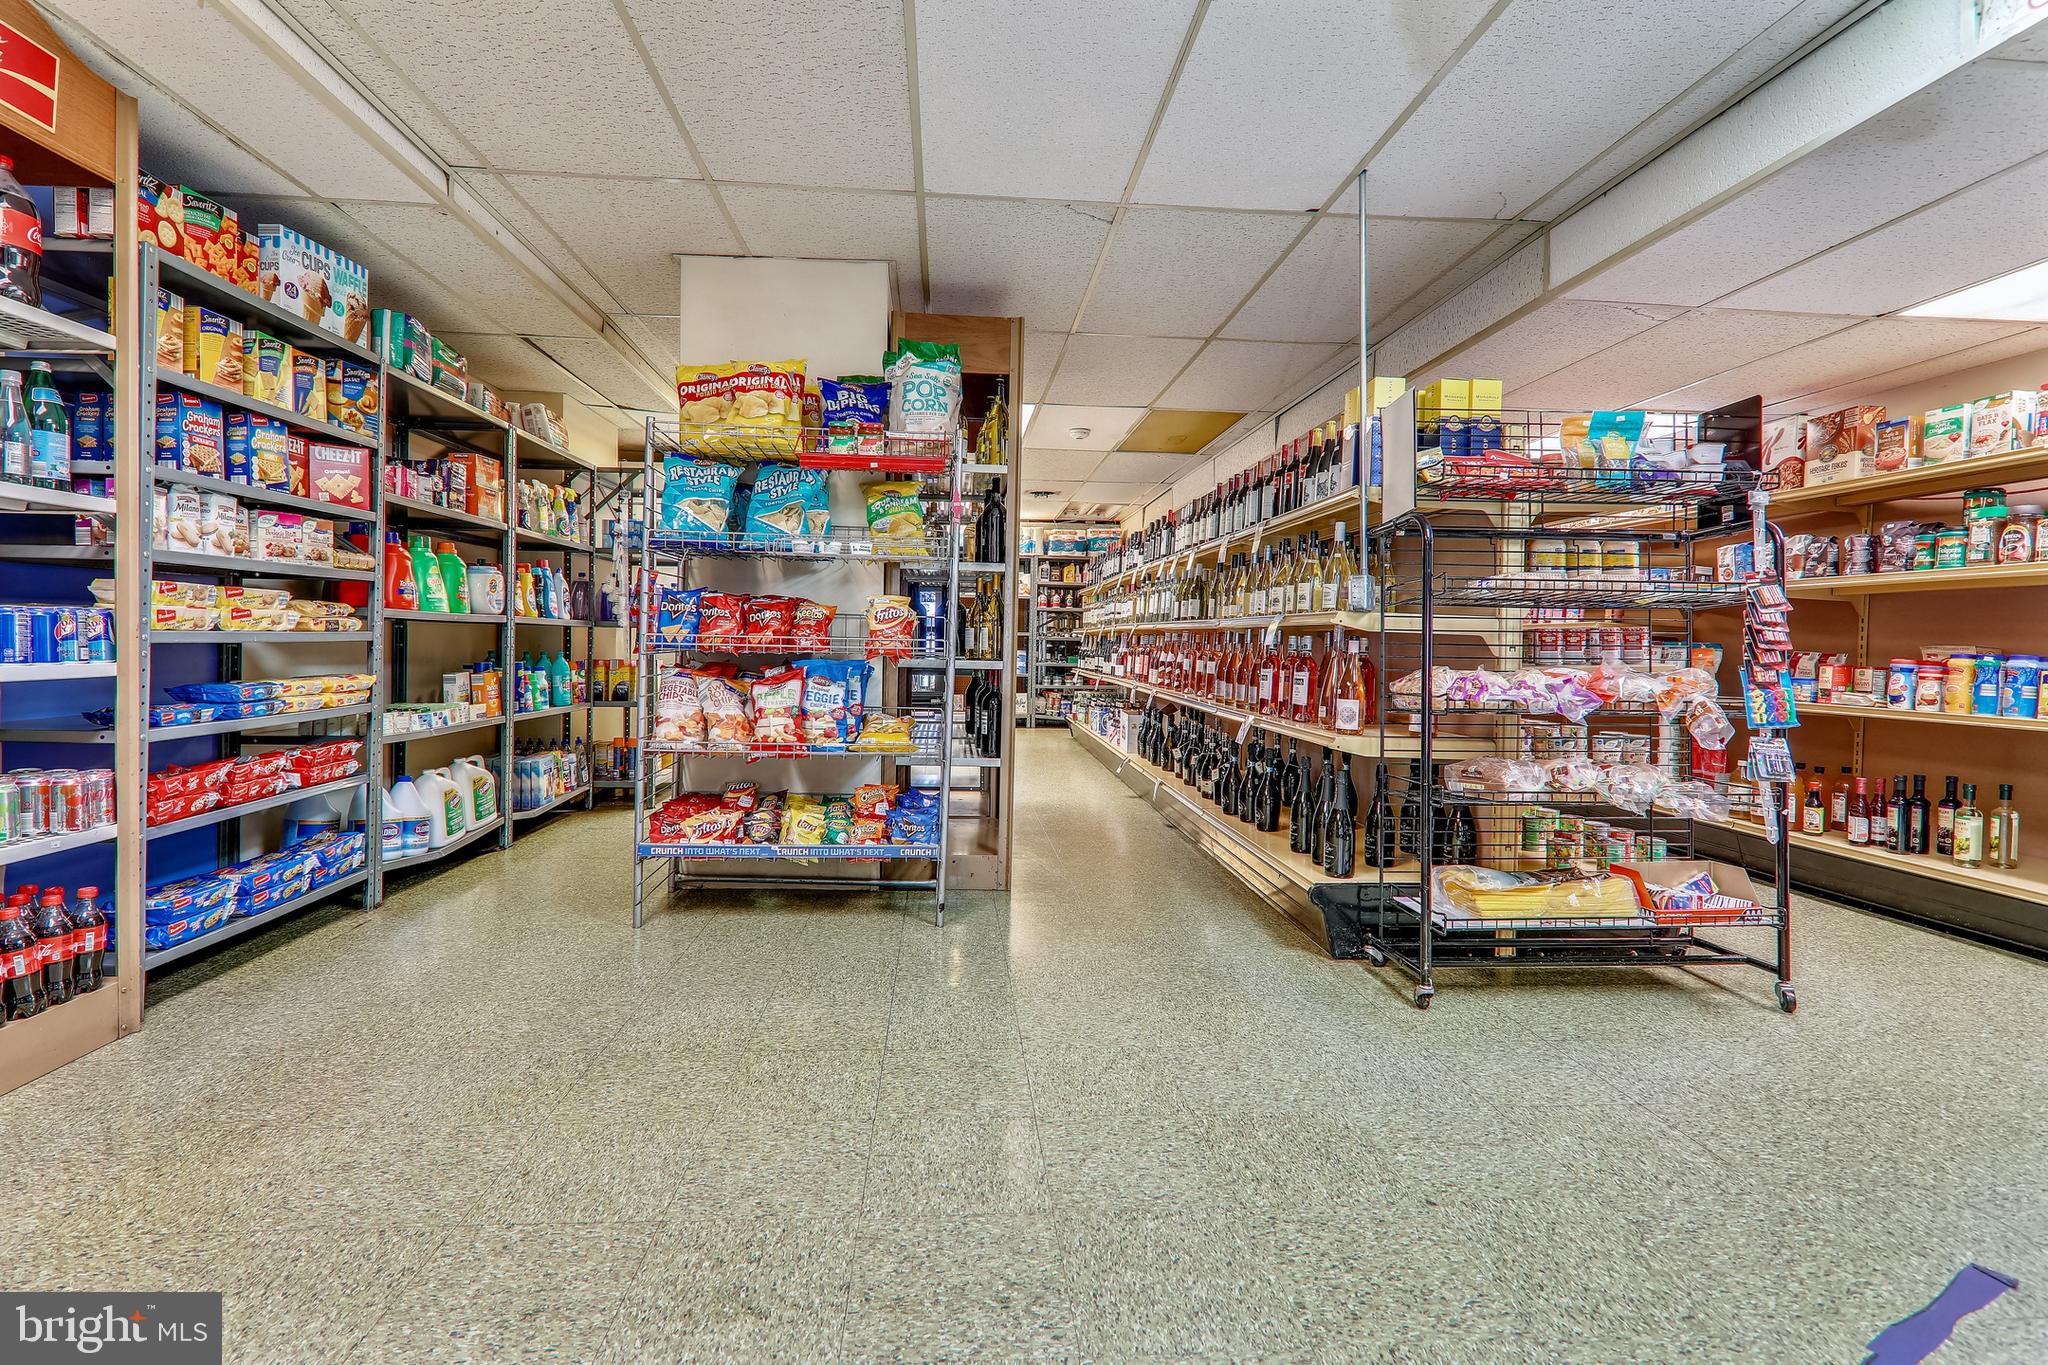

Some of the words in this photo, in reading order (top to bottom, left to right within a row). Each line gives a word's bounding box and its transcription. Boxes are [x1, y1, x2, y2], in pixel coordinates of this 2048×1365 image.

[260, 261, 279, 271] CUPS
[301, 252, 331, 280] CUPS
[730, 375, 787, 389] ORIGINAL
[911, 371, 922, 380] Sea
[925, 373, 940, 382] Salt
[681, 380, 732, 396] ORIGINA
[903, 380, 946, 401] POP
[838, 391, 868, 404] BIG
[827, 399, 880, 414] DIPPERS
[902, 399, 948, 413] CORN
[187, 411, 221, 427] Graham
[182, 419, 221, 437] Crackers
[256, 429, 286, 442] Graham
[314, 446, 362, 464] CHEEZ-IT
[687, 476, 720, 486] STYLE
[769, 483, 798, 499] STYLE
[175, 502, 200, 512] Milano
[661, 601, 697, 613] Doritos
[749, 611, 781, 622] Doritos
[875, 607, 905, 624] Fritos
[659, 691, 684, 702] CHIPS
[805, 690, 840, 705] EGGIE
[660, 824, 682, 835] Dorit
[694, 821, 722, 838] Fritos
[899, 823, 926, 834] Doritos
[900, 848, 932, 856] CRUNCH
